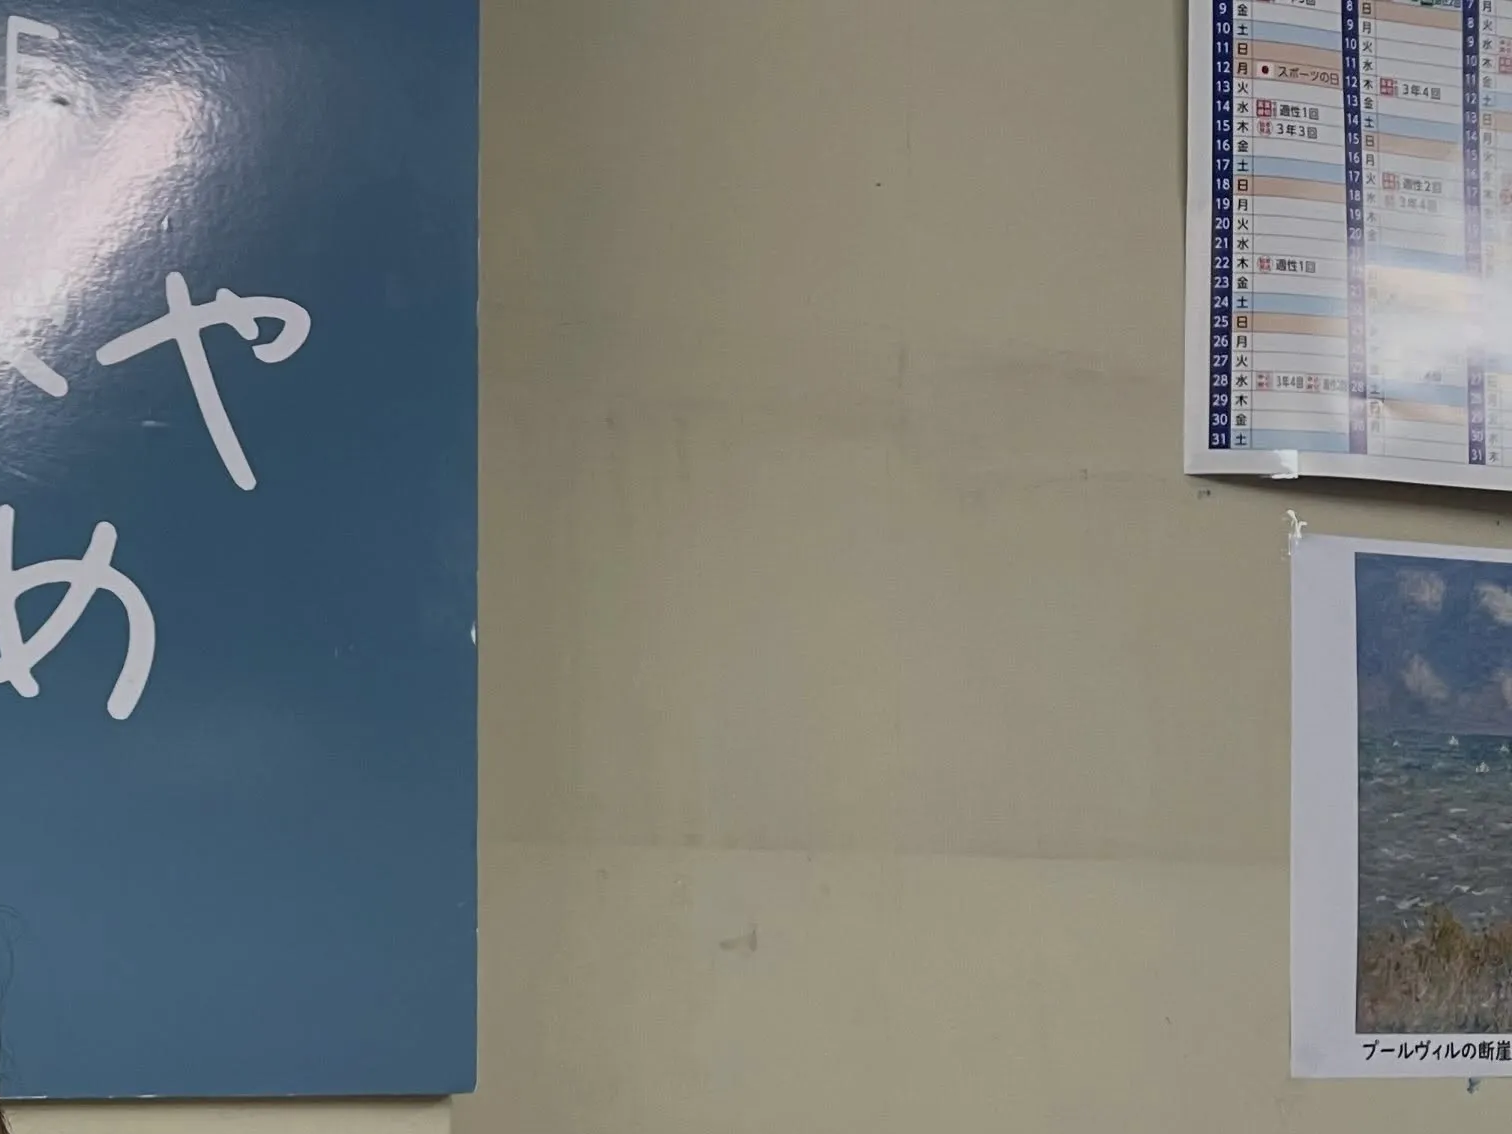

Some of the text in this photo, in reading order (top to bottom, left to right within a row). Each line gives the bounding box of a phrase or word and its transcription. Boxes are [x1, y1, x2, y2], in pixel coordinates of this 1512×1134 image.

[1219, 3, 1247, 16] 9 金
[1346, 0, 1372, 14] 8 日
[1483, 1, 1491, 12] 月
[1217, 22, 1248, 35] 10 土
[1347, 19, 1372, 34] 9 月
[1468, 17, 1493, 31] 8 火
[1217, 42, 1248, 55] 11 日
[1345, 38, 1373, 52] 10 火
[1468, 36, 1474, 47] 9
[1483, 39, 1493, 51] 水
[1346, 57, 1373, 71] 11 水
[1467, 55, 1477, 66] 10
[1217, 61, 1340, 86] 12 月 スポーツの日
[1466, 74, 1476, 85] 11
[1216, 81, 1248, 93] 13 火
[1346, 76, 1358, 88] 12
[1364, 80, 1374, 89] 木
[1402, 83, 1441, 100] 3年4回
[1347, 95, 1374, 109] 13 金
[1466, 93, 1476, 104] 12
[1216, 100, 1230, 112] 14
[1238, 102, 1248, 113] 水
[1347, 113, 1375, 128] 14 土
[1216, 120, 1230, 132] 15
[1237, 122, 1248, 133] 木
[1276, 123, 1318, 139] 3年3回
[1217, 139, 1248, 152] 16 金
[1348, 133, 1375, 147] 15 日
[1217, 159, 1248, 171] 17 土
[1348, 152, 1375, 166] 16 月
[1349, 171, 1360, 182] 17
[1366, 173, 1376, 184] 火
[1217, 179, 1248, 191] 18 日
[1349, 190, 1361, 201] 18
[1216, 198, 1247, 211] 19 月
[1350, 209, 1361, 220] 19
[1215, 218, 1248, 230] 20 火
[1215, 238, 1248, 250] 21 水
[1215, 257, 1229, 268] 22
[1238, 258, 1248, 269] 木
[1215, 276, 1248, 289] 23 金
[1214, 296, 1248, 308] 24 土
[1214, 316, 1247, 328] 25 日
[1214, 335, 1247, 348] 26 月
[1214, 355, 1247, 367] 27 火
[1213, 375, 1228, 386] 28
[1236, 375, 1247, 387] 水
[1351, 381, 1364, 393] 28
[1213, 394, 1247, 406] 29 木
[1213, 414, 1246, 426] 30 金
[1212, 433, 1246, 445] 31 土
[1472, 429, 1483, 441] 30
[1471, 449, 1483, 461] 31
